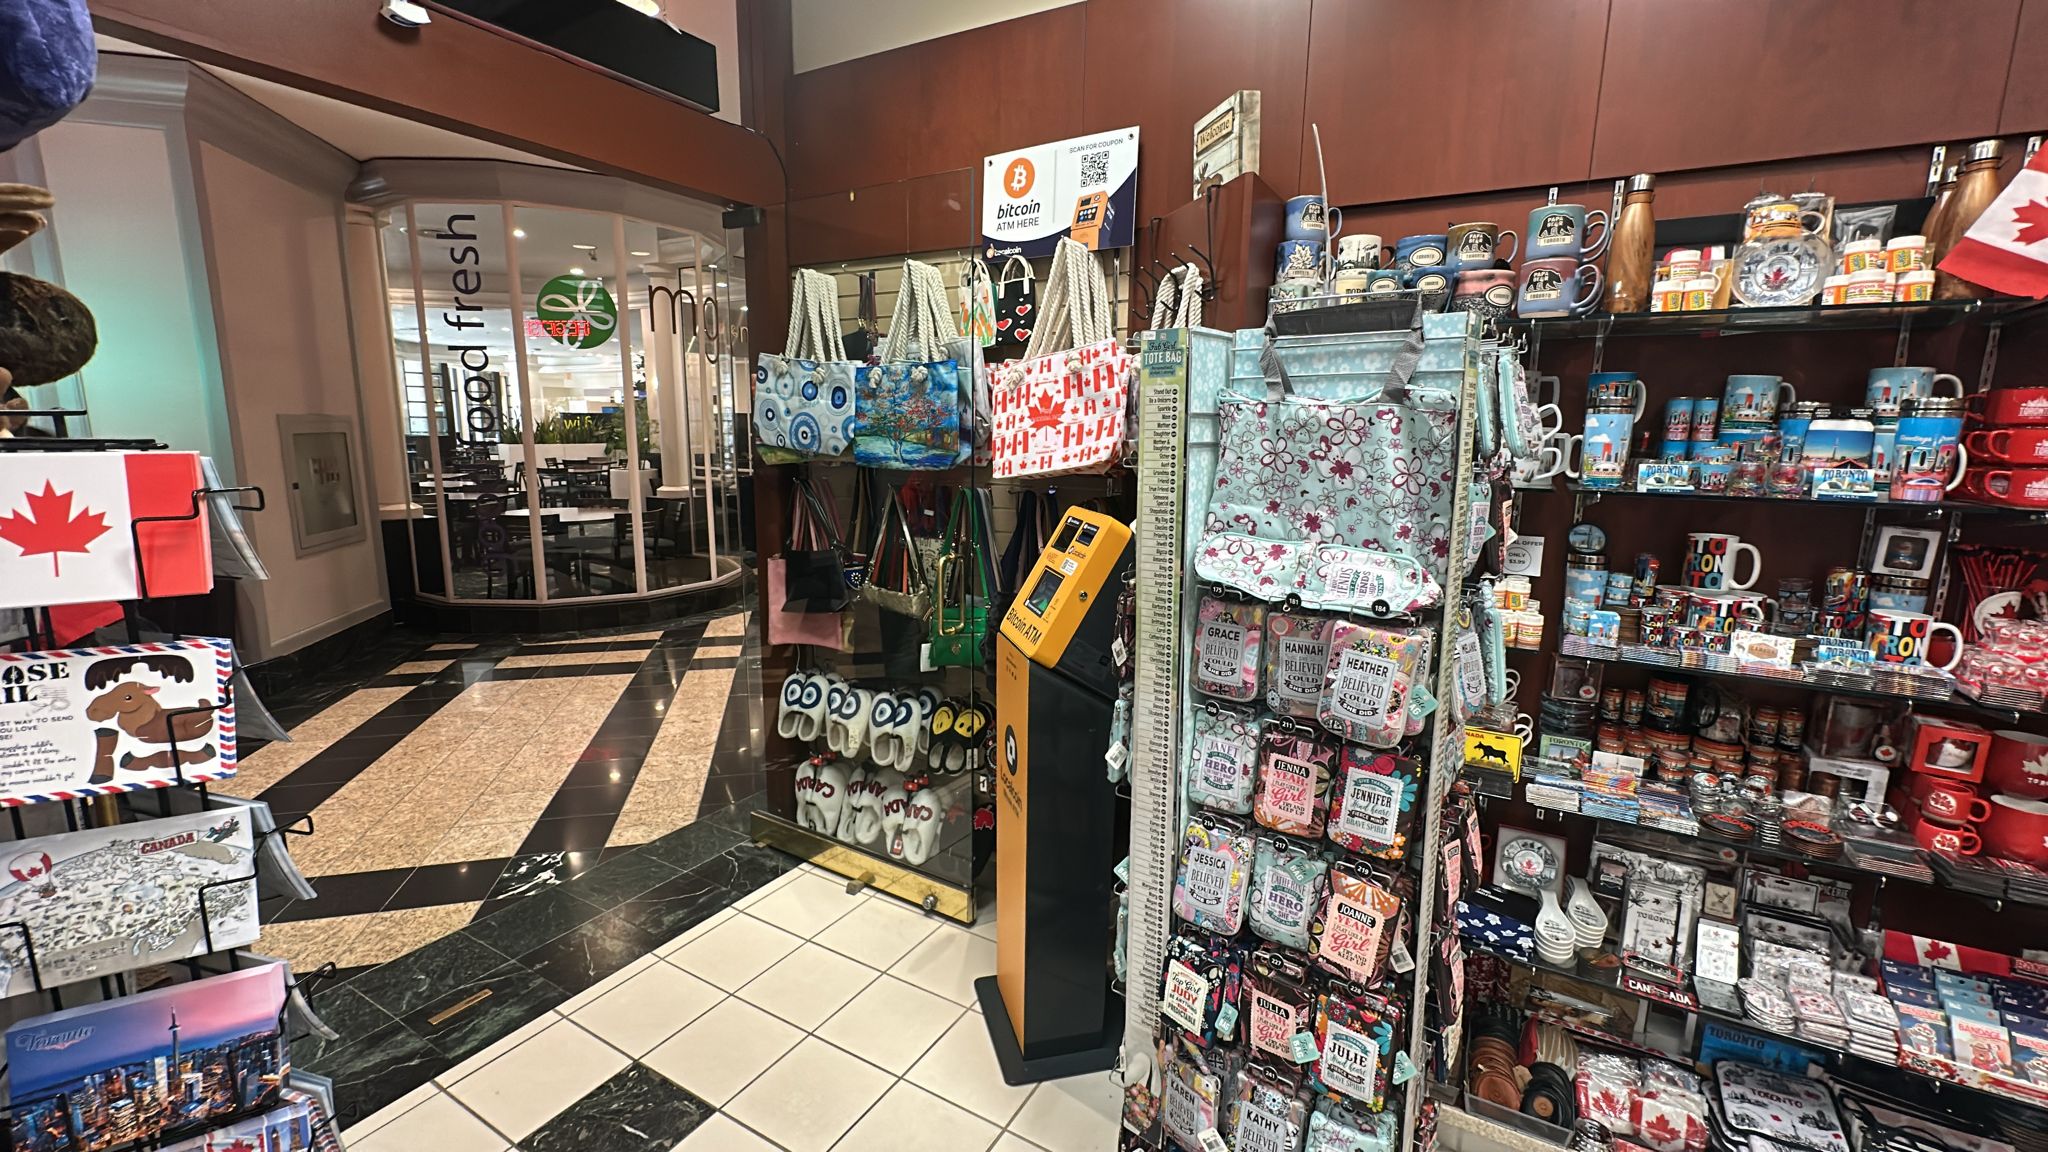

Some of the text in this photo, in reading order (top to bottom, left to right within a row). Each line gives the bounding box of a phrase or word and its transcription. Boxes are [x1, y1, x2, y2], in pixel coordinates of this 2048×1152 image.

[1200, 119, 1230, 145] Welcome
[1069, 145, 1085, 153] SCAN
[1098, 138, 1123, 147] COUPON
[997, 199, 1040, 219] bitcoin
[996, 216, 1039, 232] ATM HERE
[436, 213, 485, 331] fresh
[1144, 350, 1182, 365] TOTE BAG
[447, 345, 500, 450] food
[1694, 537, 1727, 556] TO
[1691, 554, 1726, 573] RON
[1212, 586, 1222, 594] 175
[1690, 571, 1723, 590] TO
[1374, 604, 1387, 613] 184
[1006, 606, 1043, 646] Bitcoin ATM
[1207, 626, 1240, 641] GRACE
[1892, 618, 1929, 637] TO
[1205, 643, 1238, 660] BELIEVED
[1285, 642, 1324, 656] HANNAH
[1824, 647, 1870, 662] TORONTO
[1886, 635, 1925, 657] RON
[1284, 659, 1323, 676] BELIEVED
[1346, 657, 1389, 678] HEATHER
[1287, 674, 1319, 683] COULD
[1341, 675, 1384, 699] BELIEVED
[1343, 692, 1376, 707] COULD
[1408, 700, 1421, 715] AG
[15, 725, 39, 733] LOVE
[1282, 721, 1293, 729] 211
[1207, 740, 1240, 758] JANET
[1204, 758, 1236, 775] HERO
[1277, 761, 1306, 777] JENNA
[1272, 786, 1306, 806] Girl
[1350, 787, 1392, 808] JENNIFER
[1203, 819, 1213, 827] 214
[141, 832, 195, 854] CANADA
[1275, 841, 1286, 849] 217
[1194, 853, 1226, 870] JESSICA
[1357, 865, 1369, 875] 219
[1191, 869, 1224, 890] BELIEVED
[1289, 864, 1304, 881] BAG
[1268, 891, 1303, 912] HERO
[1340, 904, 1374, 927] JOANNE
[1337, 914, 1369, 937] YEAH
[1330, 932, 1370, 952] Girl
[1172, 975, 1201, 994] Top Girl
[1171, 984, 1198, 1005] JUDY
[1260, 998, 1287, 1018] JULIA
[15, 1025, 95, 1051] Toronto
[1709, 1028, 1765, 1049] TORONTO
[1292, 1039, 1304, 1059] BAG
[1329, 1042, 1368, 1068] JULIE
[1265, 1070, 1275, 1079] 241
[1170, 1079, 1195, 1105] KAREN
[1751, 1088, 1803, 1109] TORONTO
[1169, 1094, 1195, 1120] BELIEVED
[1246, 1108, 1280, 1133] KATHY
